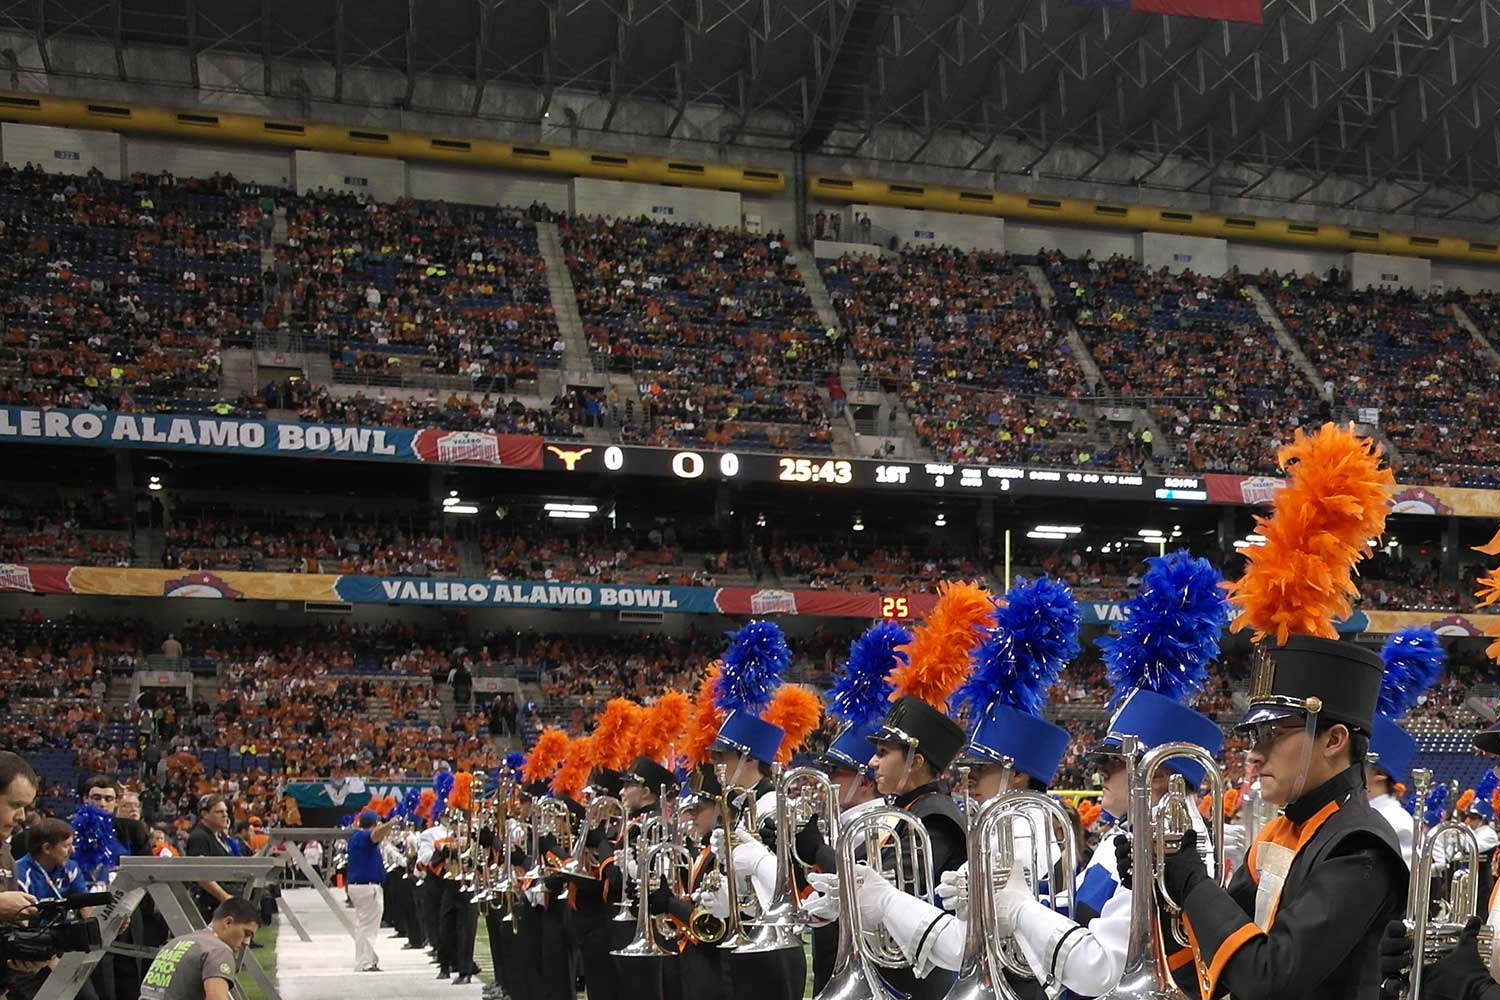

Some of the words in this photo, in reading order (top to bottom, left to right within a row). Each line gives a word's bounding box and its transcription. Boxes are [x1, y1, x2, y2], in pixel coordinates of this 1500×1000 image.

[111, 416, 265, 448] ALAMO
[277, 424, 396, 456] BOWL
[604, 446, 624, 471] 0
[719, 453, 740, 477] 0
[779, 458, 853, 485] 25:43
[876, 465, 910, 483] 1ST
[381, 579, 489, 602] VALERO
[493, 585, 592, 606] ALAMO
[600, 588, 678, 608] BOWL
[883, 597, 909, 618] 25
